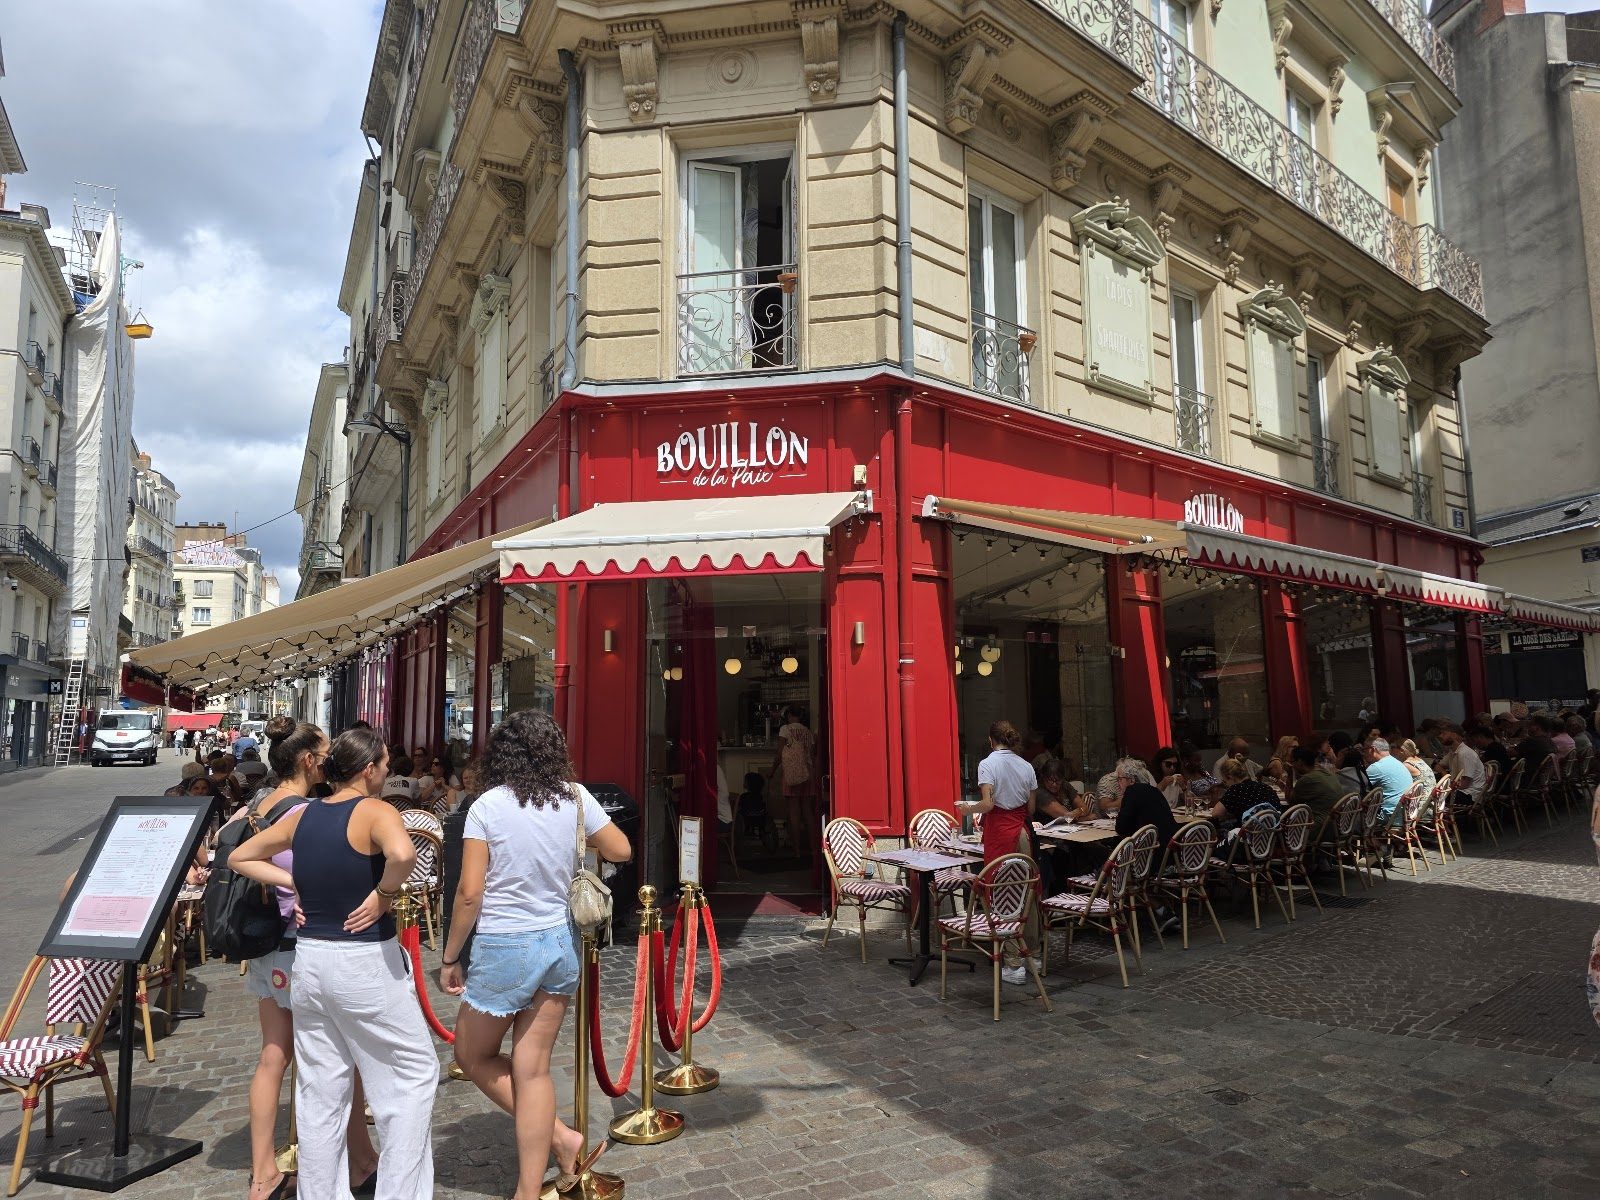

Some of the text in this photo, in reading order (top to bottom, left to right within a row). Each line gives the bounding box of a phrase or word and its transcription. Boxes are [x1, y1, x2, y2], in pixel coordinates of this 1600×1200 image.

[1105, 275, 1133, 308] TAPIS
[656, 421, 809, 472] BOUILLON
[693, 458, 774, 488] de la Paix
[1183, 493, 1244, 534] BOUILLON
[1513, 636, 1522, 645] LA
[1523, 635, 1538, 644] ROSE
[1539, 634, 1552, 643] DES
